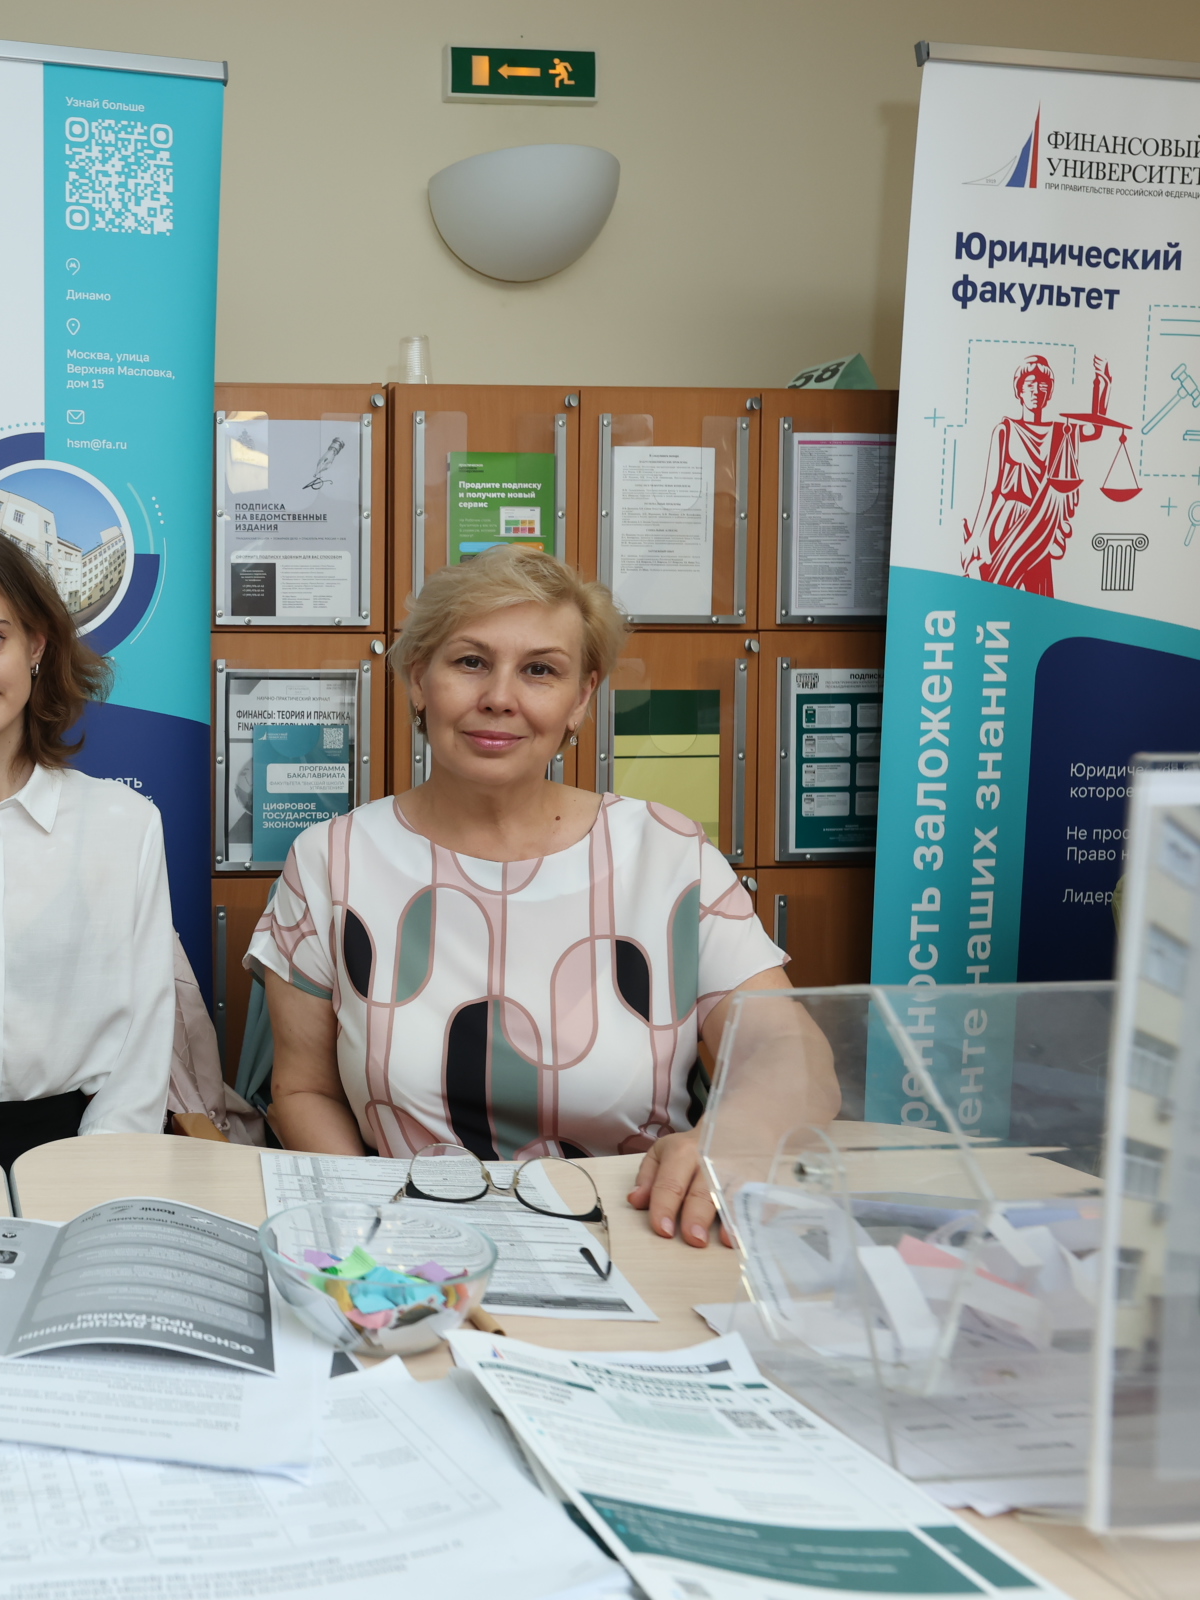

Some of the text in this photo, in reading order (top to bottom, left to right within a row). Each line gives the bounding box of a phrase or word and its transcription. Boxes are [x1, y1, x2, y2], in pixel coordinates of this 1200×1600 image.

[65, 96, 145, 112] Узнай больше
[1045, 182, 1059, 190] ПРИ
[1060, 183, 1114, 195] ПРАВИТЕЛЬСТВЕ
[1115, 187, 1163, 197] РОССИЙСКОЙ
[955, 231, 1182, 271] Юридический
[66, 289, 111, 301] Динамо
[951, 274, 1120, 312] факультет
[66, 349, 150, 363] Москва, улица
[67, 363, 176, 380] Верхняя Масловка,
[66, 379, 105, 389] дом 15
[66, 438, 127, 451] hsm@fa.ru
[458, 481, 542, 490] Продлите подписку
[466, 491, 506, 499] получите
[235, 503, 286, 511] ПОДПИСКА
[458, 501, 489, 509] сервис
[249, 513, 328, 522] ВЕДОМСТВЕННЫЕ
[235, 524, 279, 532] ИЗДАНИЯ
[236, 709, 350, 721] ФИНАНСЫ: ТЕОРИЯ И ПРАКТИКА
[975, 621, 1011, 810] знаний
[913, 610, 956, 871] заложена
[1070, 786, 1135, 801] которое
[262, 803, 317, 811] ЦИФРОВОЕ
[262, 811, 330, 820] ГОСУДАРСТВО
[262, 821, 319, 829] ЭКОНОМИК
[1066, 826, 1131, 843] Не прос
[1067, 847, 1116, 864] Право
[139, 1206, 176, 1215] Romir
[77, 1312, 194, 1330] ПРОГРАММЫ
[18, 1320, 255, 1355] ОСНОВНЫЕ ДИСЦИПЛИНЫ
